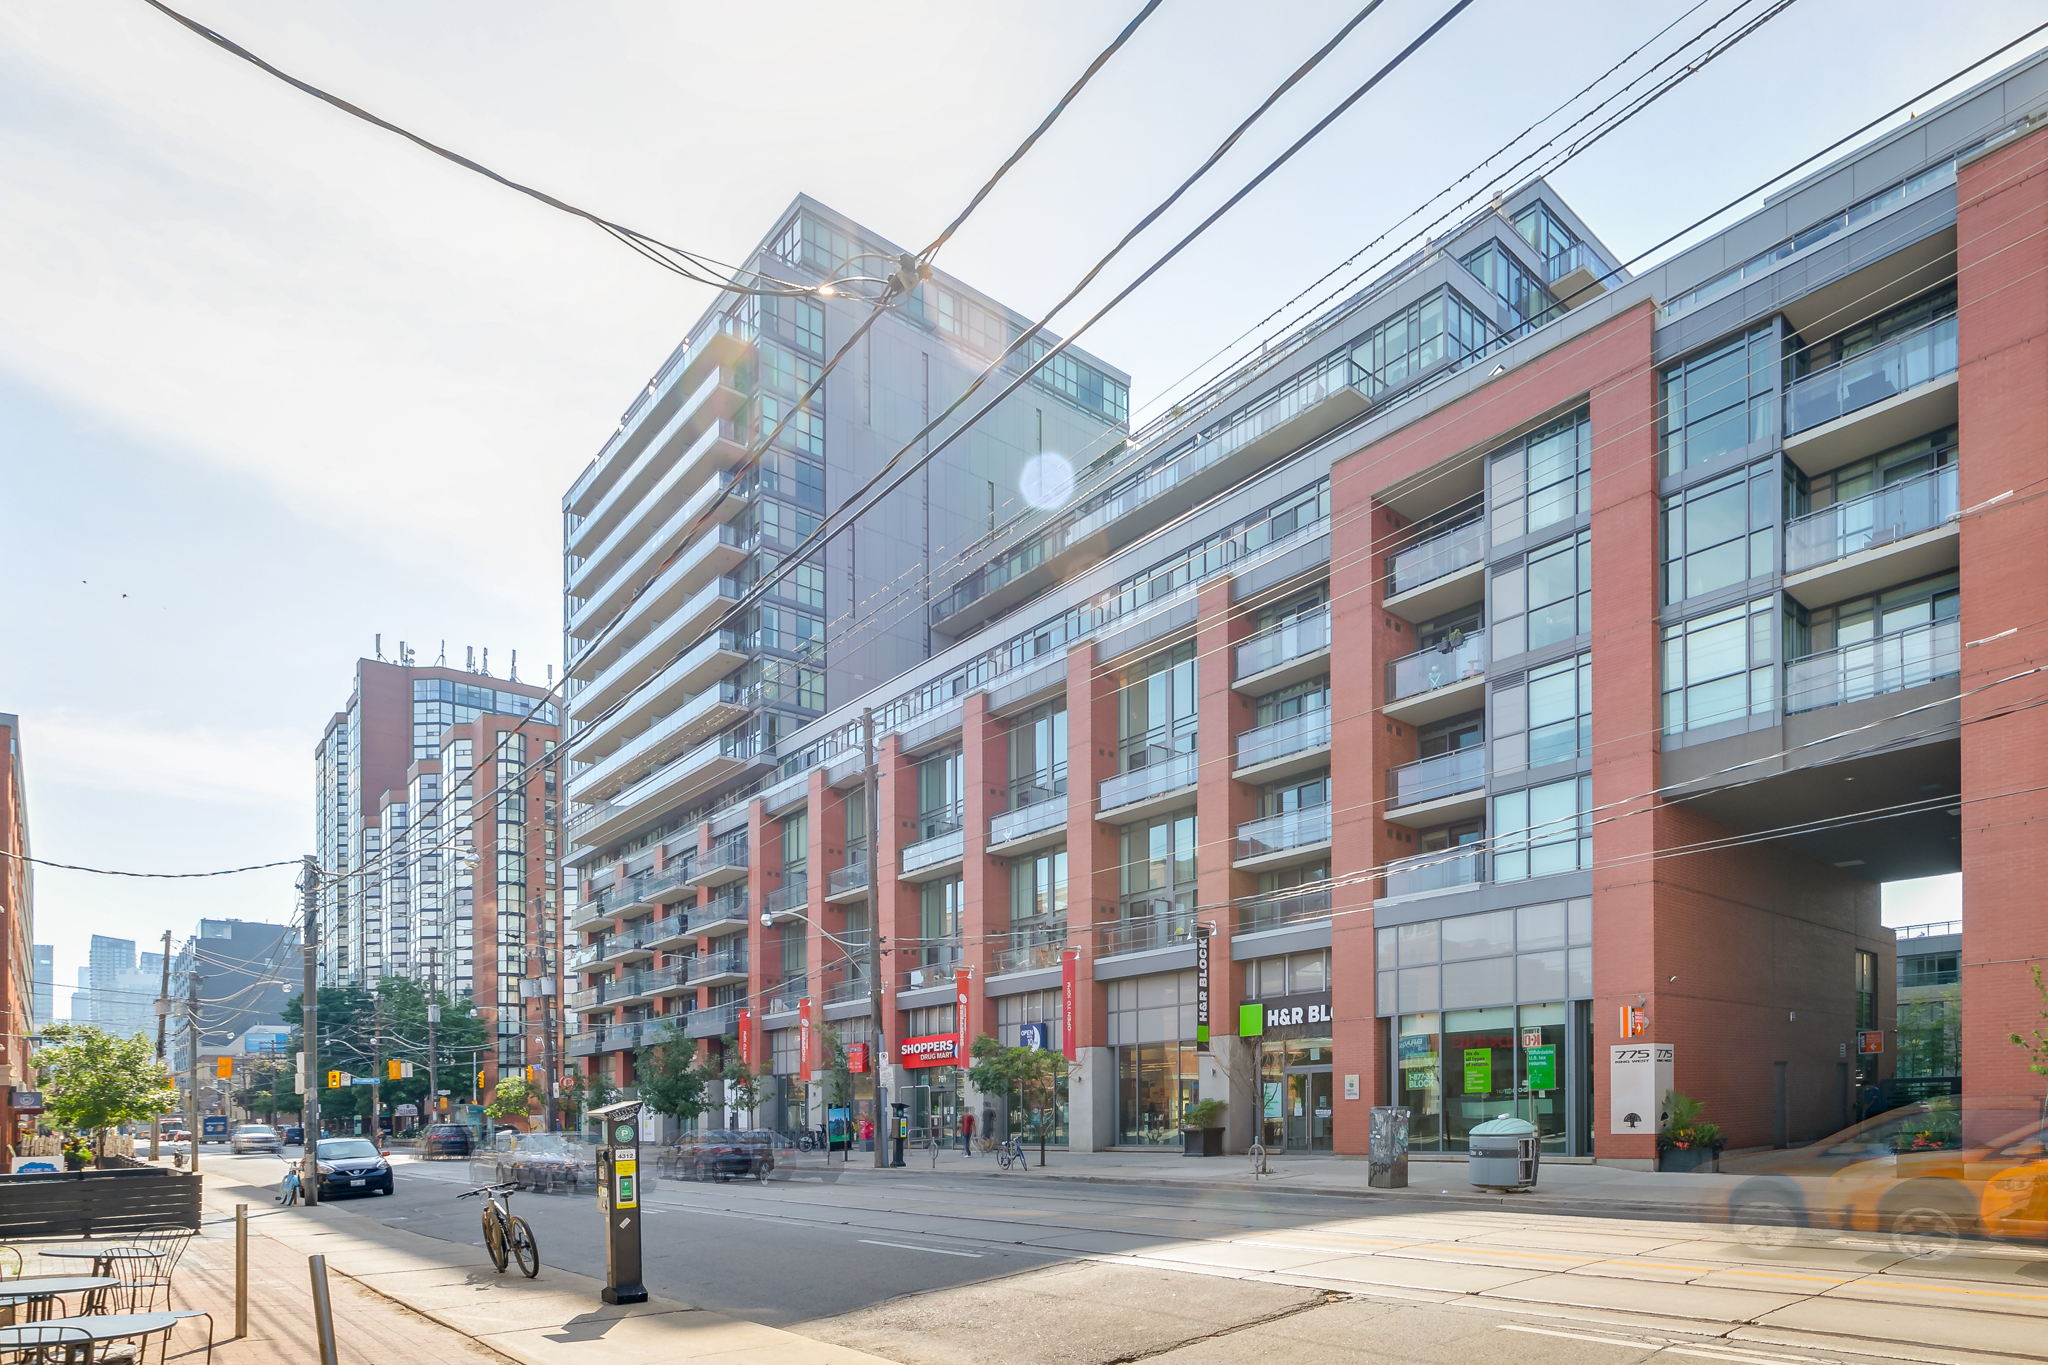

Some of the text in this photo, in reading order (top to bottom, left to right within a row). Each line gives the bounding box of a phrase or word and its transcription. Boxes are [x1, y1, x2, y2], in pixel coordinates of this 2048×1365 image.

[1199, 938, 1208, 1022] H&R BLOCK
[1067, 1001, 1072, 1010] TO
[1267, 1004, 1333, 1027] H&R BL
[901, 1040, 954, 1055] SHOPPERS
[920, 1051, 953, 1061] DRUG MART
[1615, 1049, 1650, 1059] 775
[1657, 1049, 1672, 1058] 775
[1409, 1080, 1434, 1088] BLOCK
